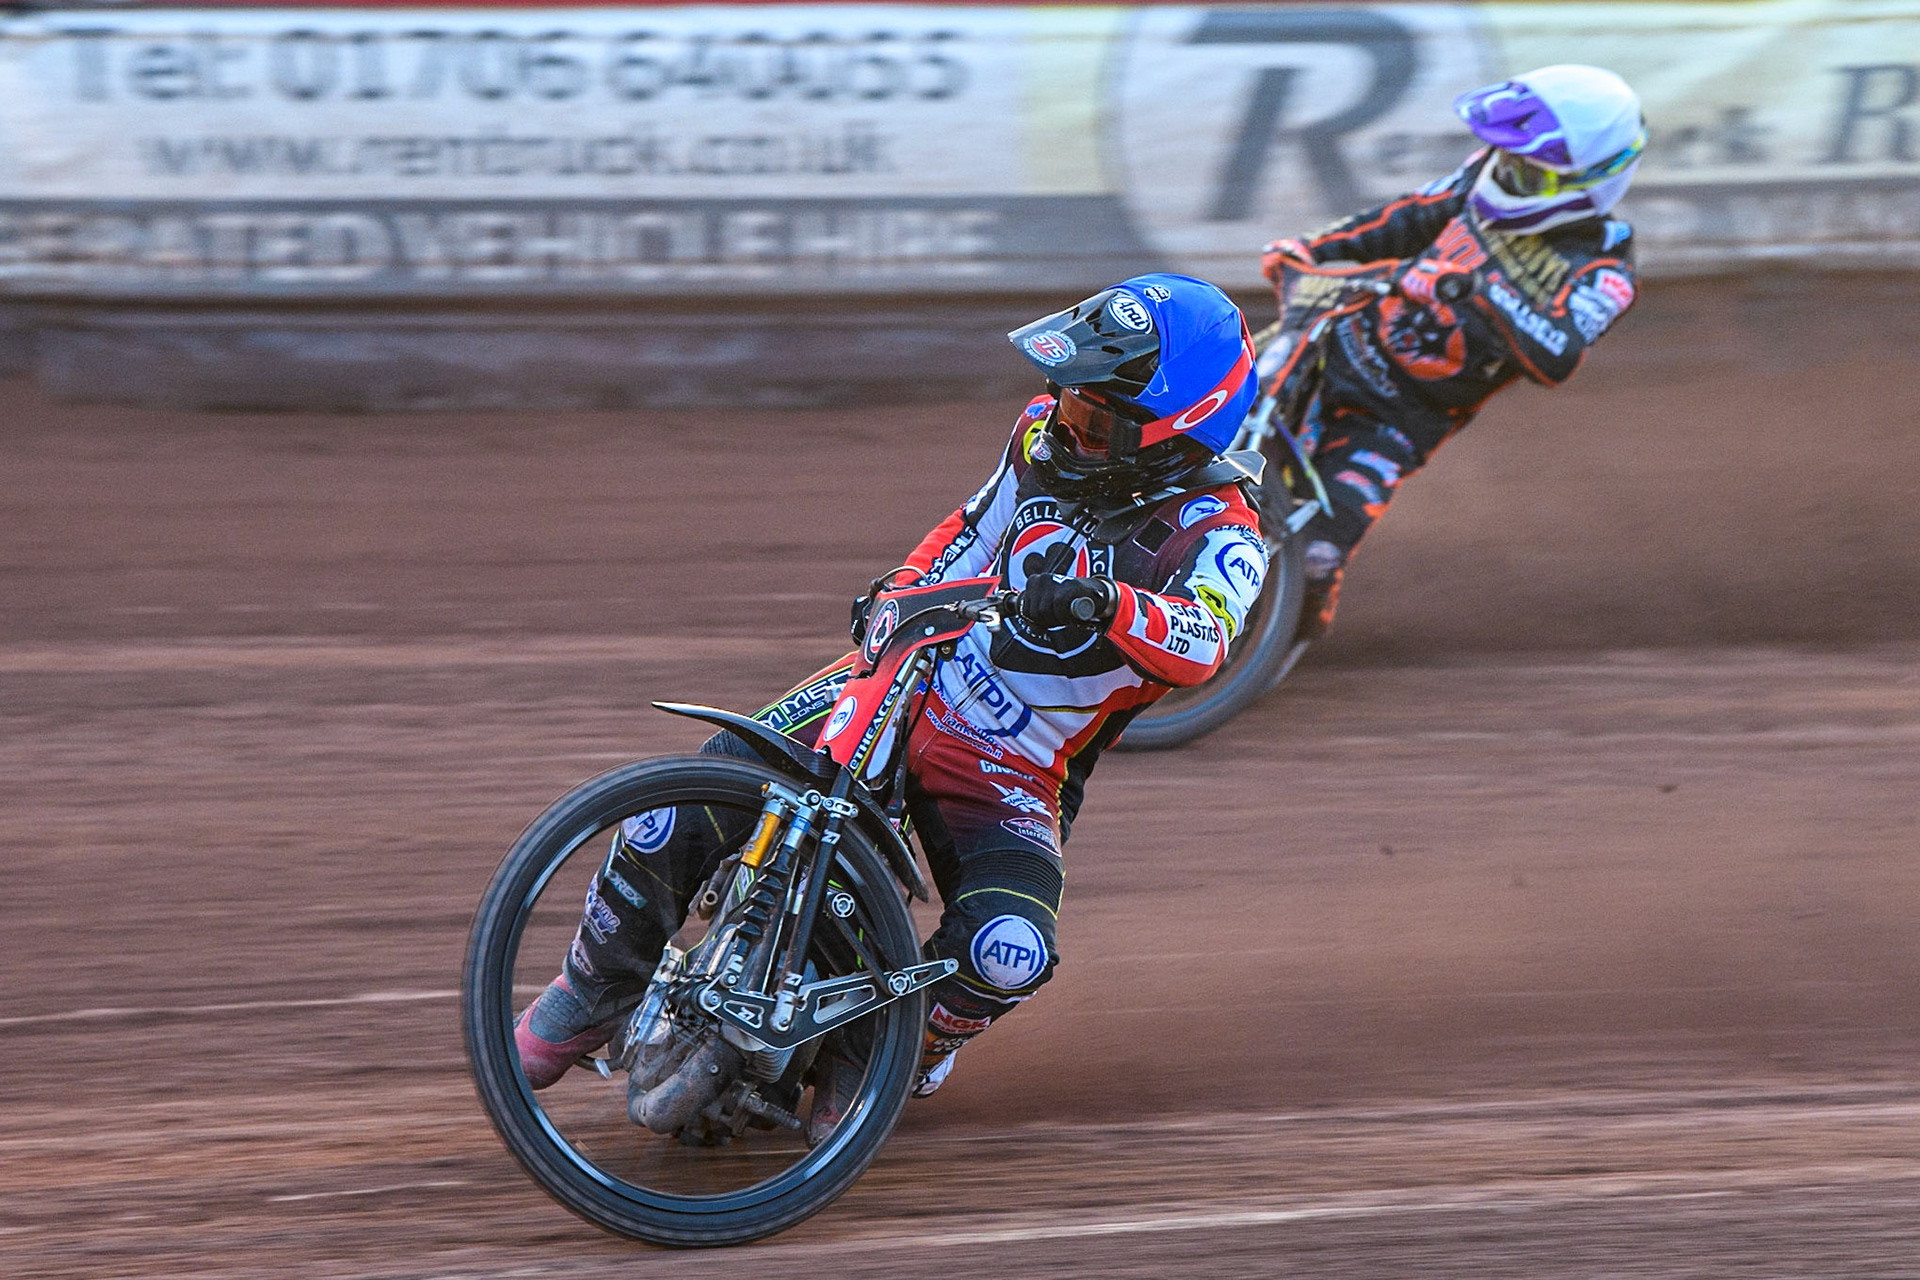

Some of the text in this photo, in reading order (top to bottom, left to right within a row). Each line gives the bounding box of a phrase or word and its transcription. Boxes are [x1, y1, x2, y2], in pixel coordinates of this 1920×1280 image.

[1118, 302, 1149, 327] Arai
[1031, 335, 1067, 358] STS
[1015, 505, 1063, 530] BELLE
[1229, 557, 1261, 593] ATP
[1167, 635, 1190, 655] LTD
[954, 653, 1012, 720] ATPI
[983, 940, 1036, 971] ATPI
[932, 1006, 989, 1030] NGK
